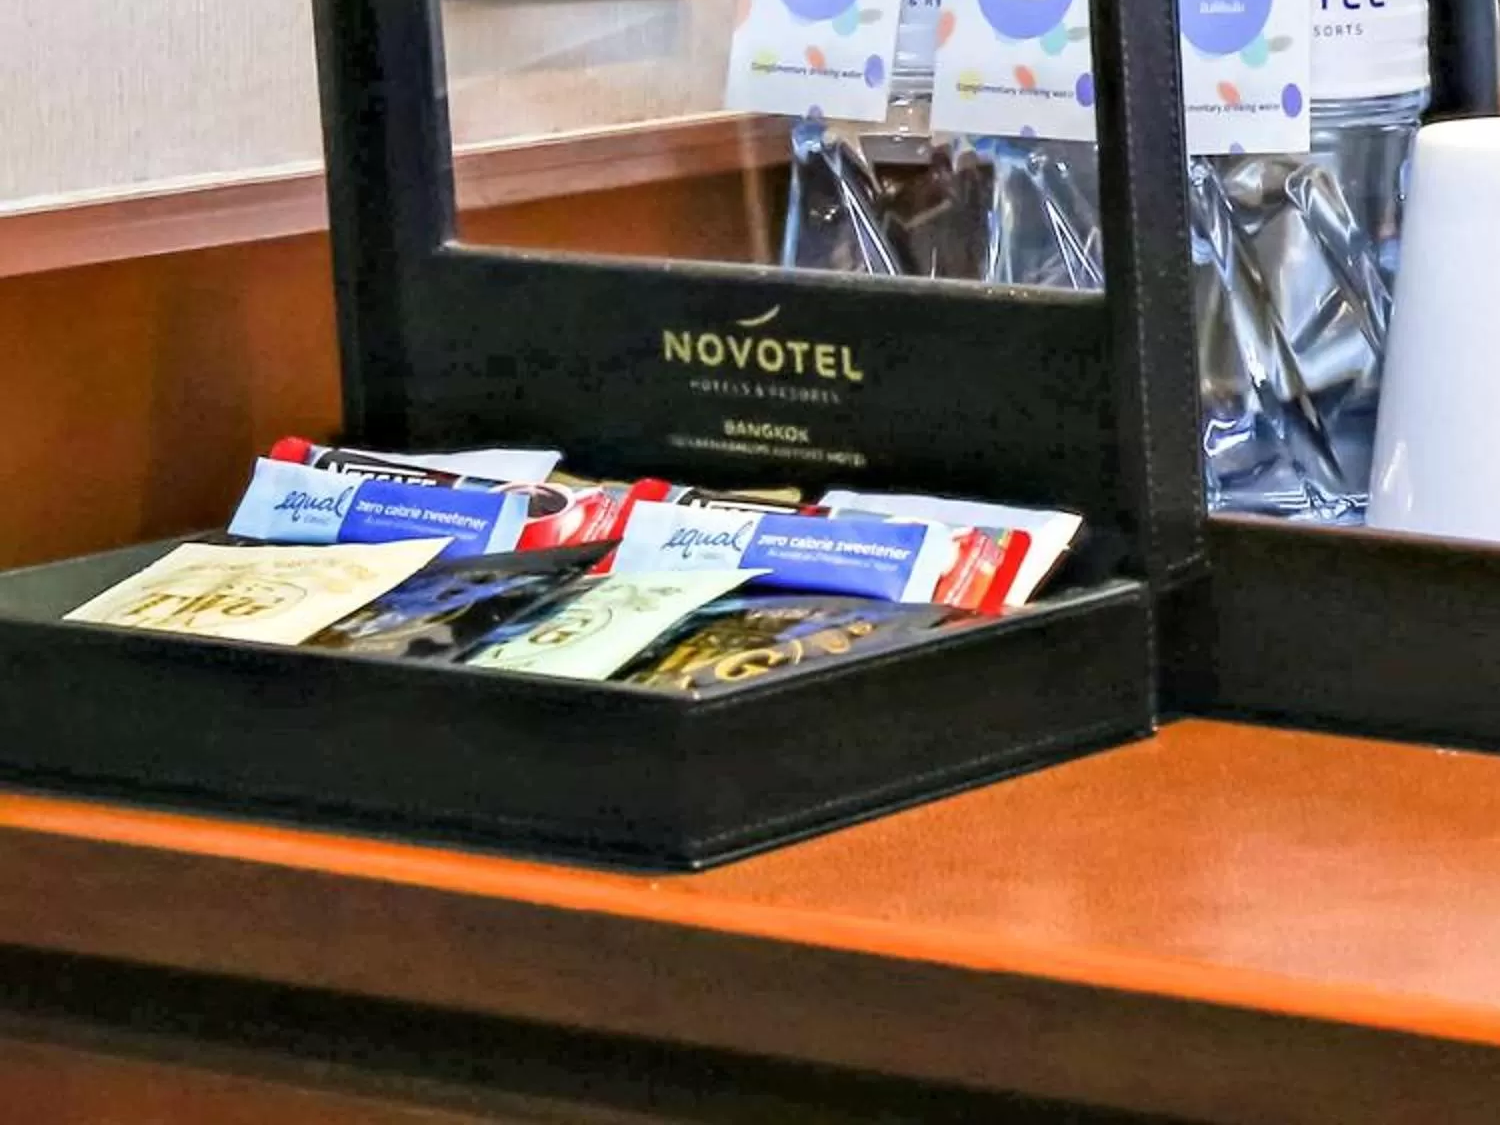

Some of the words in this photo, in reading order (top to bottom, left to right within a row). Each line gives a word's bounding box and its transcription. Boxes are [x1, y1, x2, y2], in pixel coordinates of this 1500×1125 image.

[662, 329, 865, 382] NOVOTEL
[723, 418, 810, 444] BANGKOK
[273, 485, 355, 523] equal
[355, 499, 384, 516] zero
[384, 503, 422, 521] calorie
[422, 508, 489, 531] sweetener
[660, 519, 755, 559] equal
[757, 534, 789, 548] zero
[789, 534, 834, 551] calorie
[834, 539, 913, 561] sweetener
